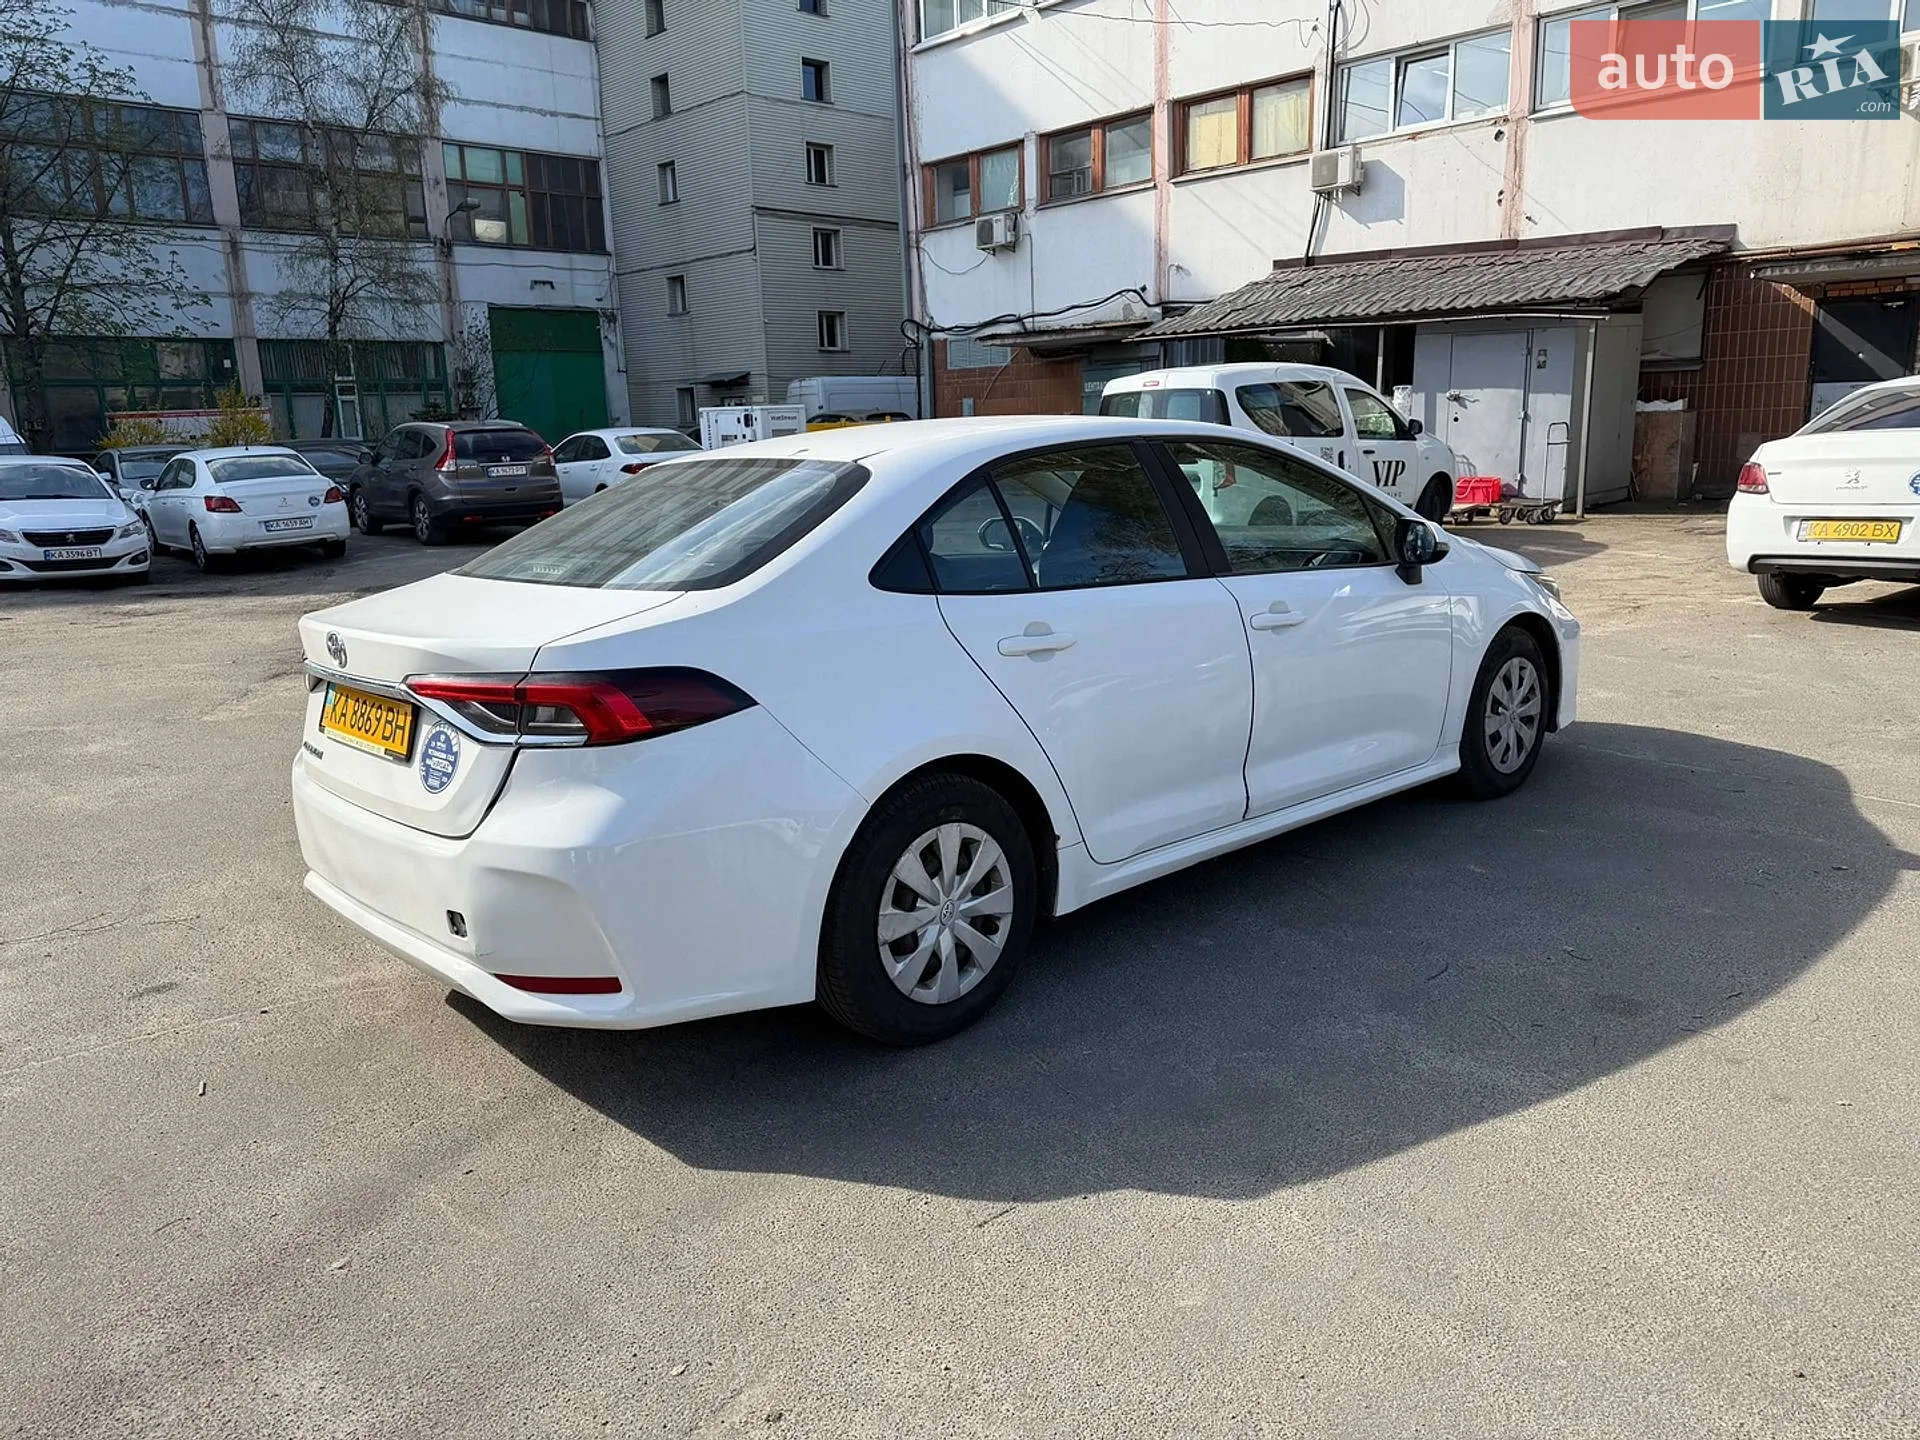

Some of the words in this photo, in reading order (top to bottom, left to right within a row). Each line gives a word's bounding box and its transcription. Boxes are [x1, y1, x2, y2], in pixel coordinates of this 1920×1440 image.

[1372, 460, 1406, 487] VIP
[1807, 523, 1828, 536] KA
[1833, 523, 1868, 536] 4902
[1871, 524, 1896, 537] BX
[50, 551, 64, 559] KA
[330, 693, 350, 727] KA
[349, 697, 384, 736] 8869
[381, 706, 408, 747] BH
